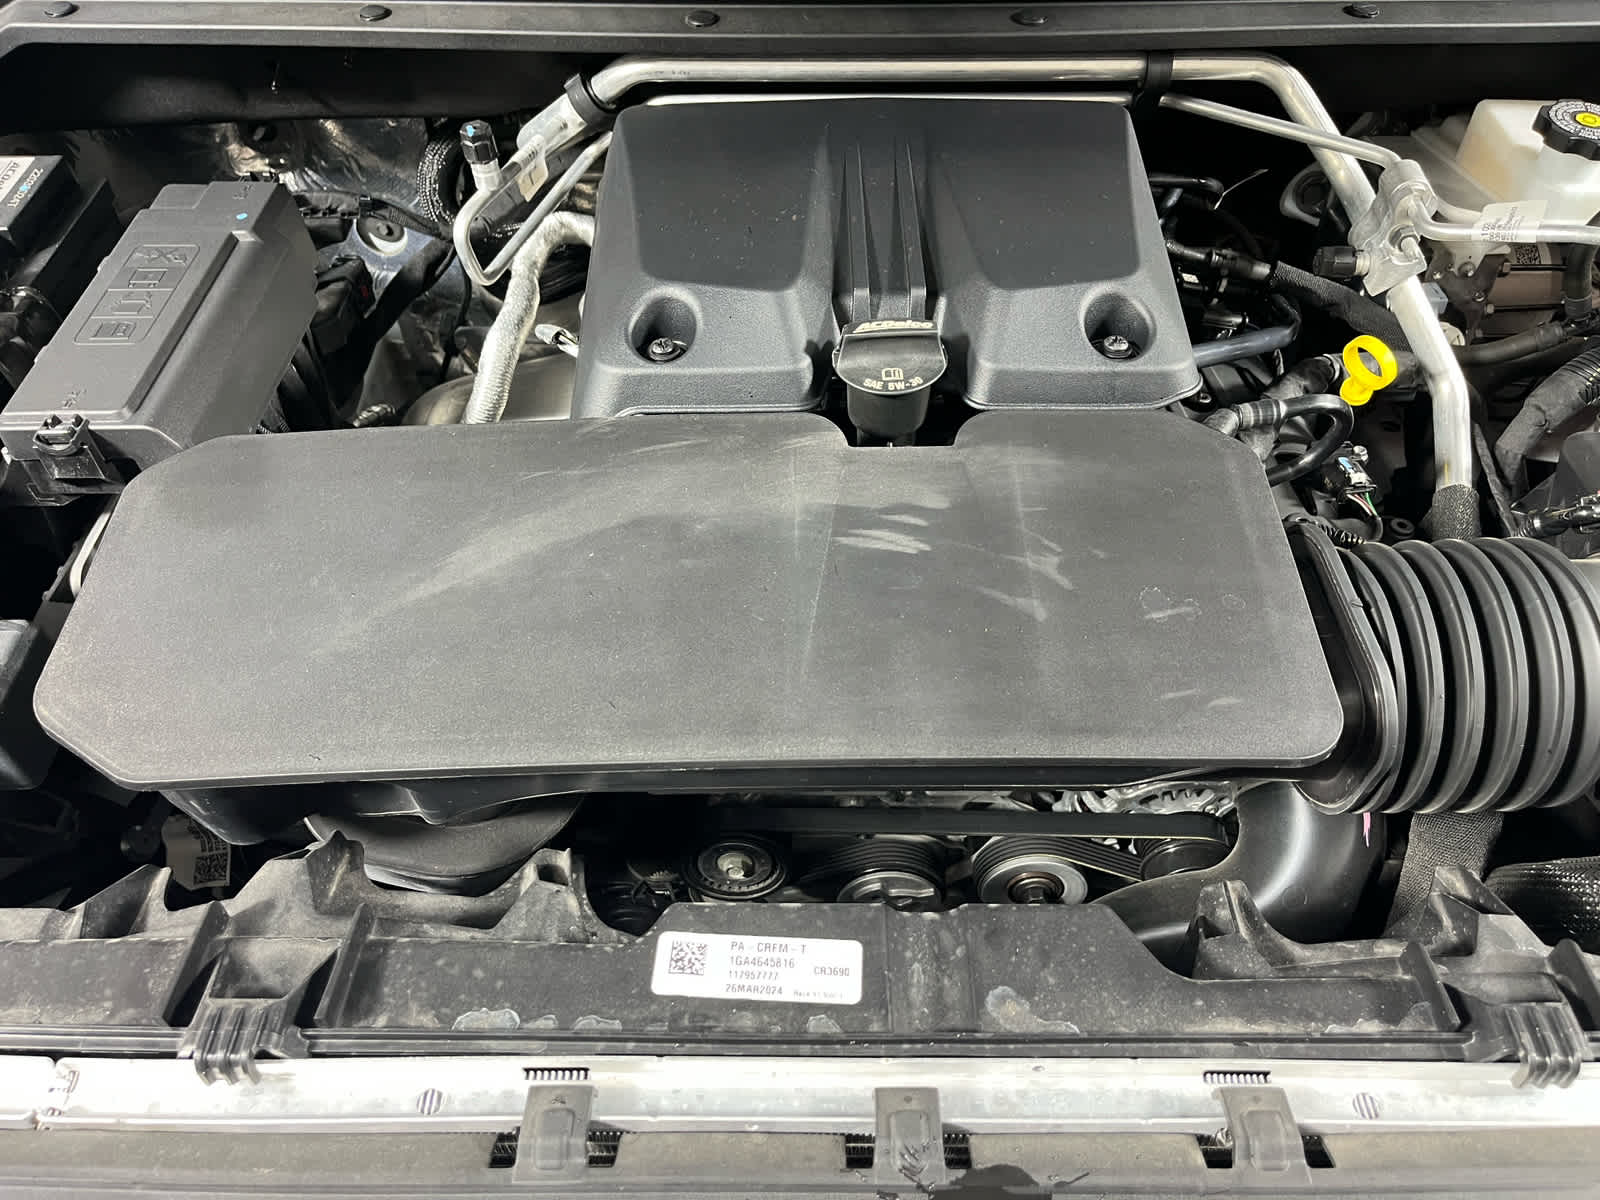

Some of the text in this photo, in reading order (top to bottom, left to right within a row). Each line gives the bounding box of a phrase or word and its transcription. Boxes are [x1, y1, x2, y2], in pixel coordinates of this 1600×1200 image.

[853, 320, 934, 333] ACDelco
[863, 376, 924, 390] SAE 5W-30
[725, 983, 783, 995] 26MAR2024
